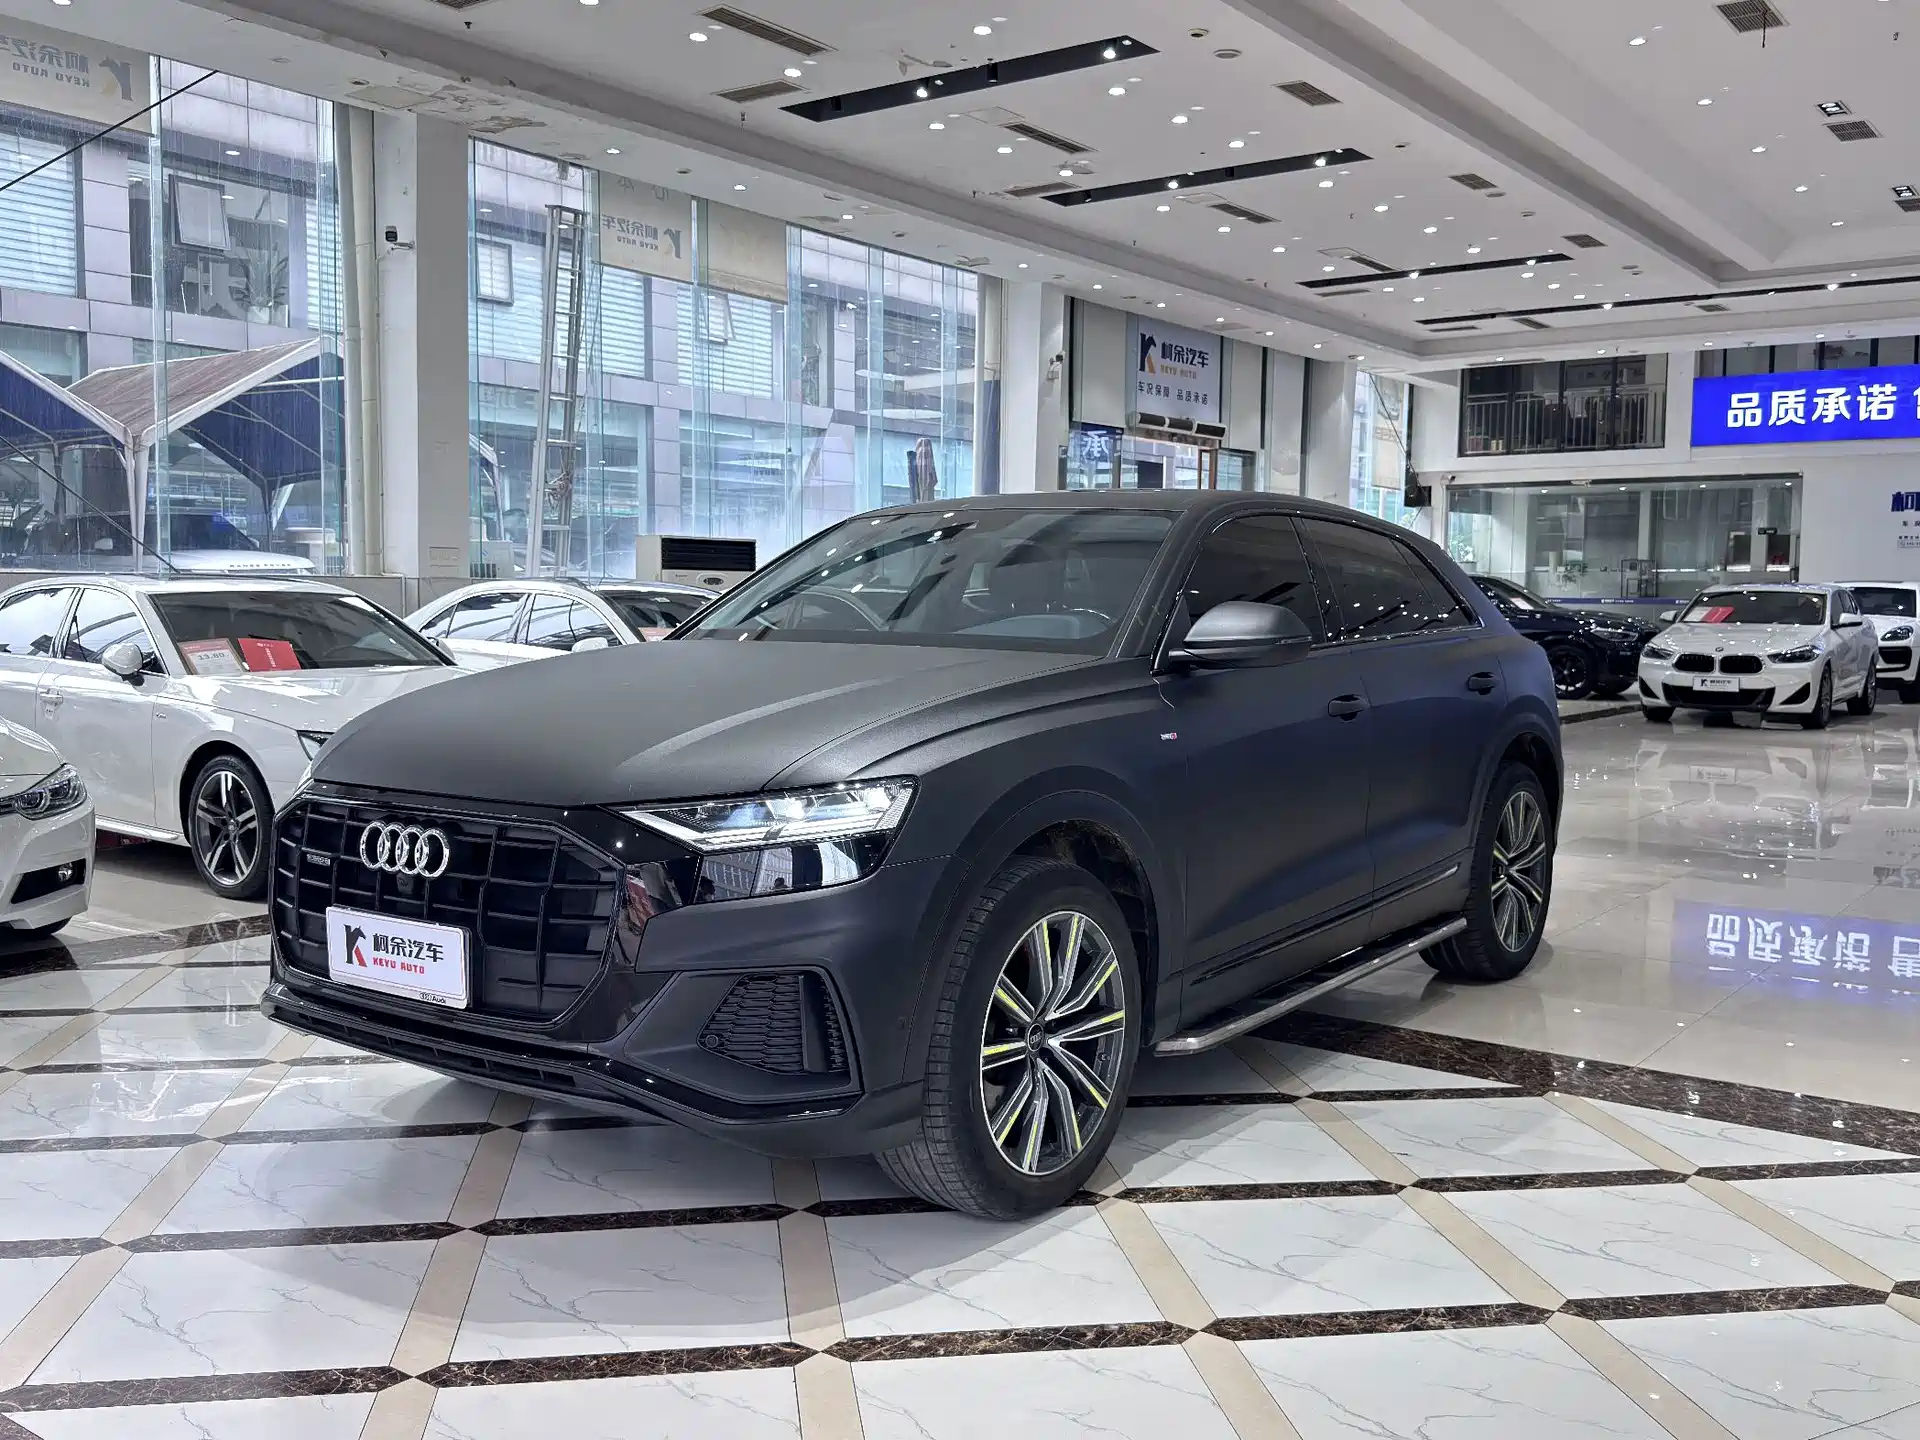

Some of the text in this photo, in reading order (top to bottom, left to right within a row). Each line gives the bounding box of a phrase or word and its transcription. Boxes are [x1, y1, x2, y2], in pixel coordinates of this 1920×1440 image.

[1161, 341, 1209, 368] 柯余汽车
[1176, 388, 1208, 405] 品质承诺
[1727, 383, 1897, 428] 品质承诺
[373, 933, 444, 962] 柯余汽车
[373, 957, 425, 974] KEYU AUTO
